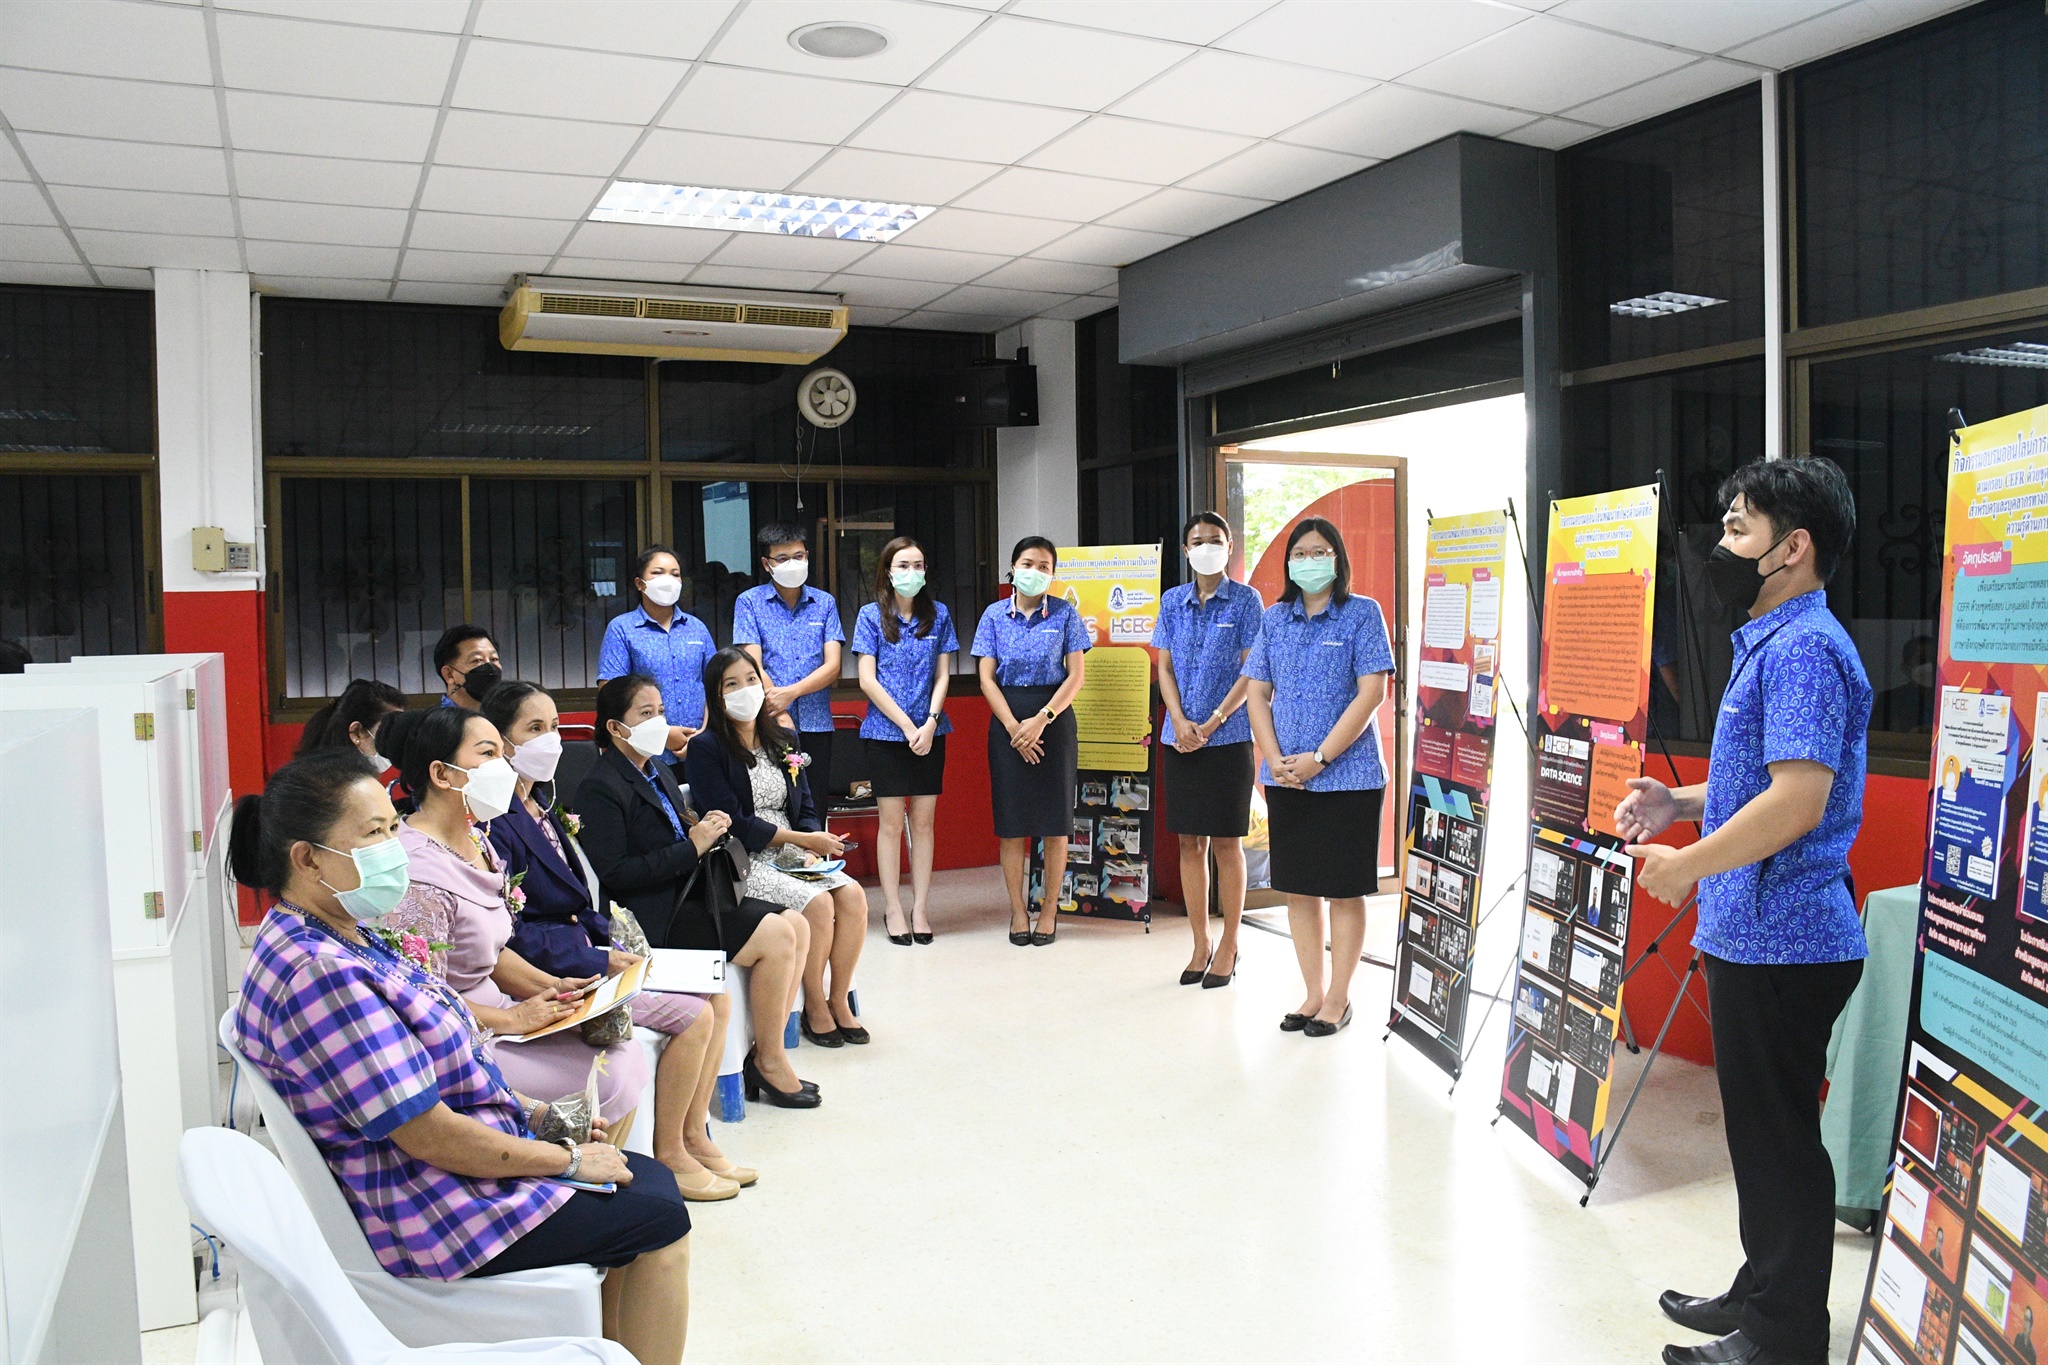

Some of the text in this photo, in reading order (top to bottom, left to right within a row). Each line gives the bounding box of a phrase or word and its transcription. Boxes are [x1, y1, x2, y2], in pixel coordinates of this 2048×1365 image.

[1953, 430, 2048, 473] กิจกรรมอบรมออนไลน์การ
[2005, 471, 2025, 488] CEFR
[1962, 547, 2002, 569] วัตถุประสงค์
[1112, 618, 1152, 634] HCEC
[1540, 766, 1583, 786] DATA SCIENCE
